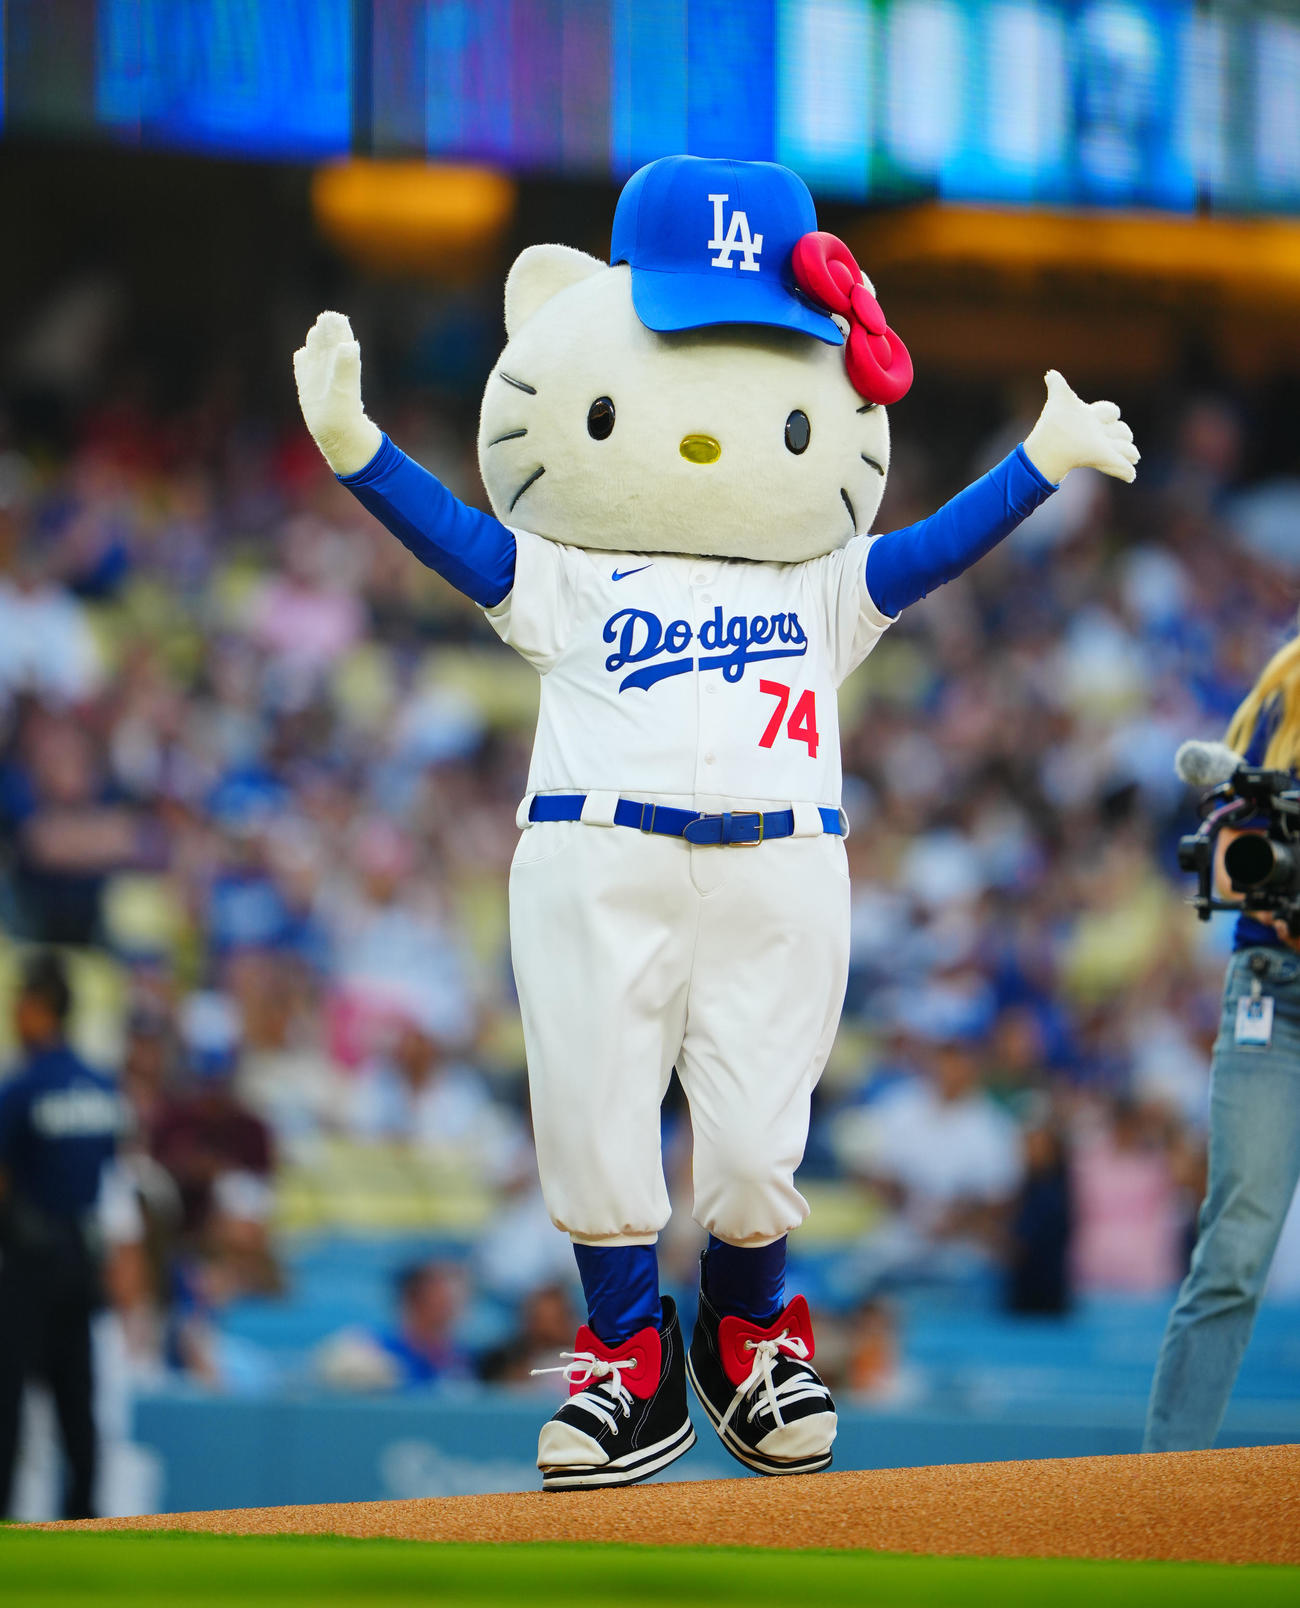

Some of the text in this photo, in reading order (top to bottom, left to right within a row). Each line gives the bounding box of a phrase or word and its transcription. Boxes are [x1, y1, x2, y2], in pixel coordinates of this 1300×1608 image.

[708, 194, 763, 272] LA
[603, 606, 807, 683] Dodgers
[758, 679, 819, 759] 74
